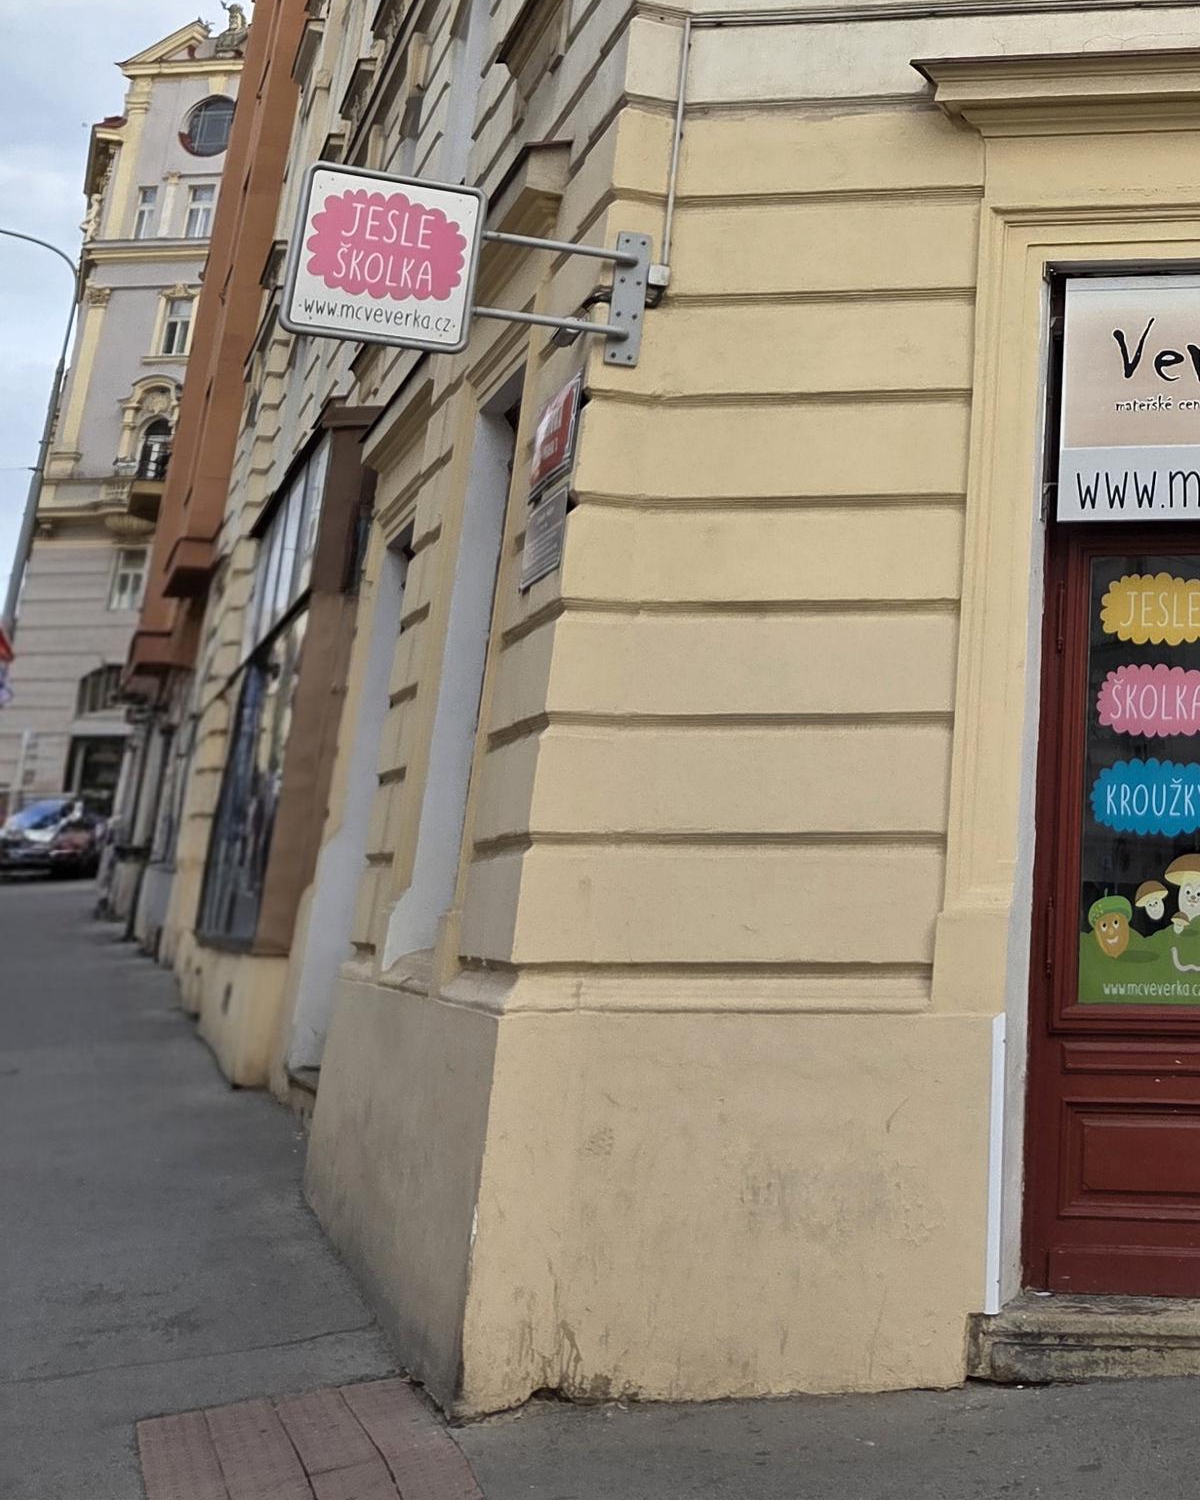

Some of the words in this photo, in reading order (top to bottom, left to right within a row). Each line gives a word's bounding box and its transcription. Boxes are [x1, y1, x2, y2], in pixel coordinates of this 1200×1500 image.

[341, 203, 435, 249] JESLE
[332, 243, 433, 292] ŠKOLKA
[304, 299, 451, 332] www.mcveverka.cz
[1115, 395, 1172, 412] mateřské
[1119, 591, 1200, 628] JESLE
